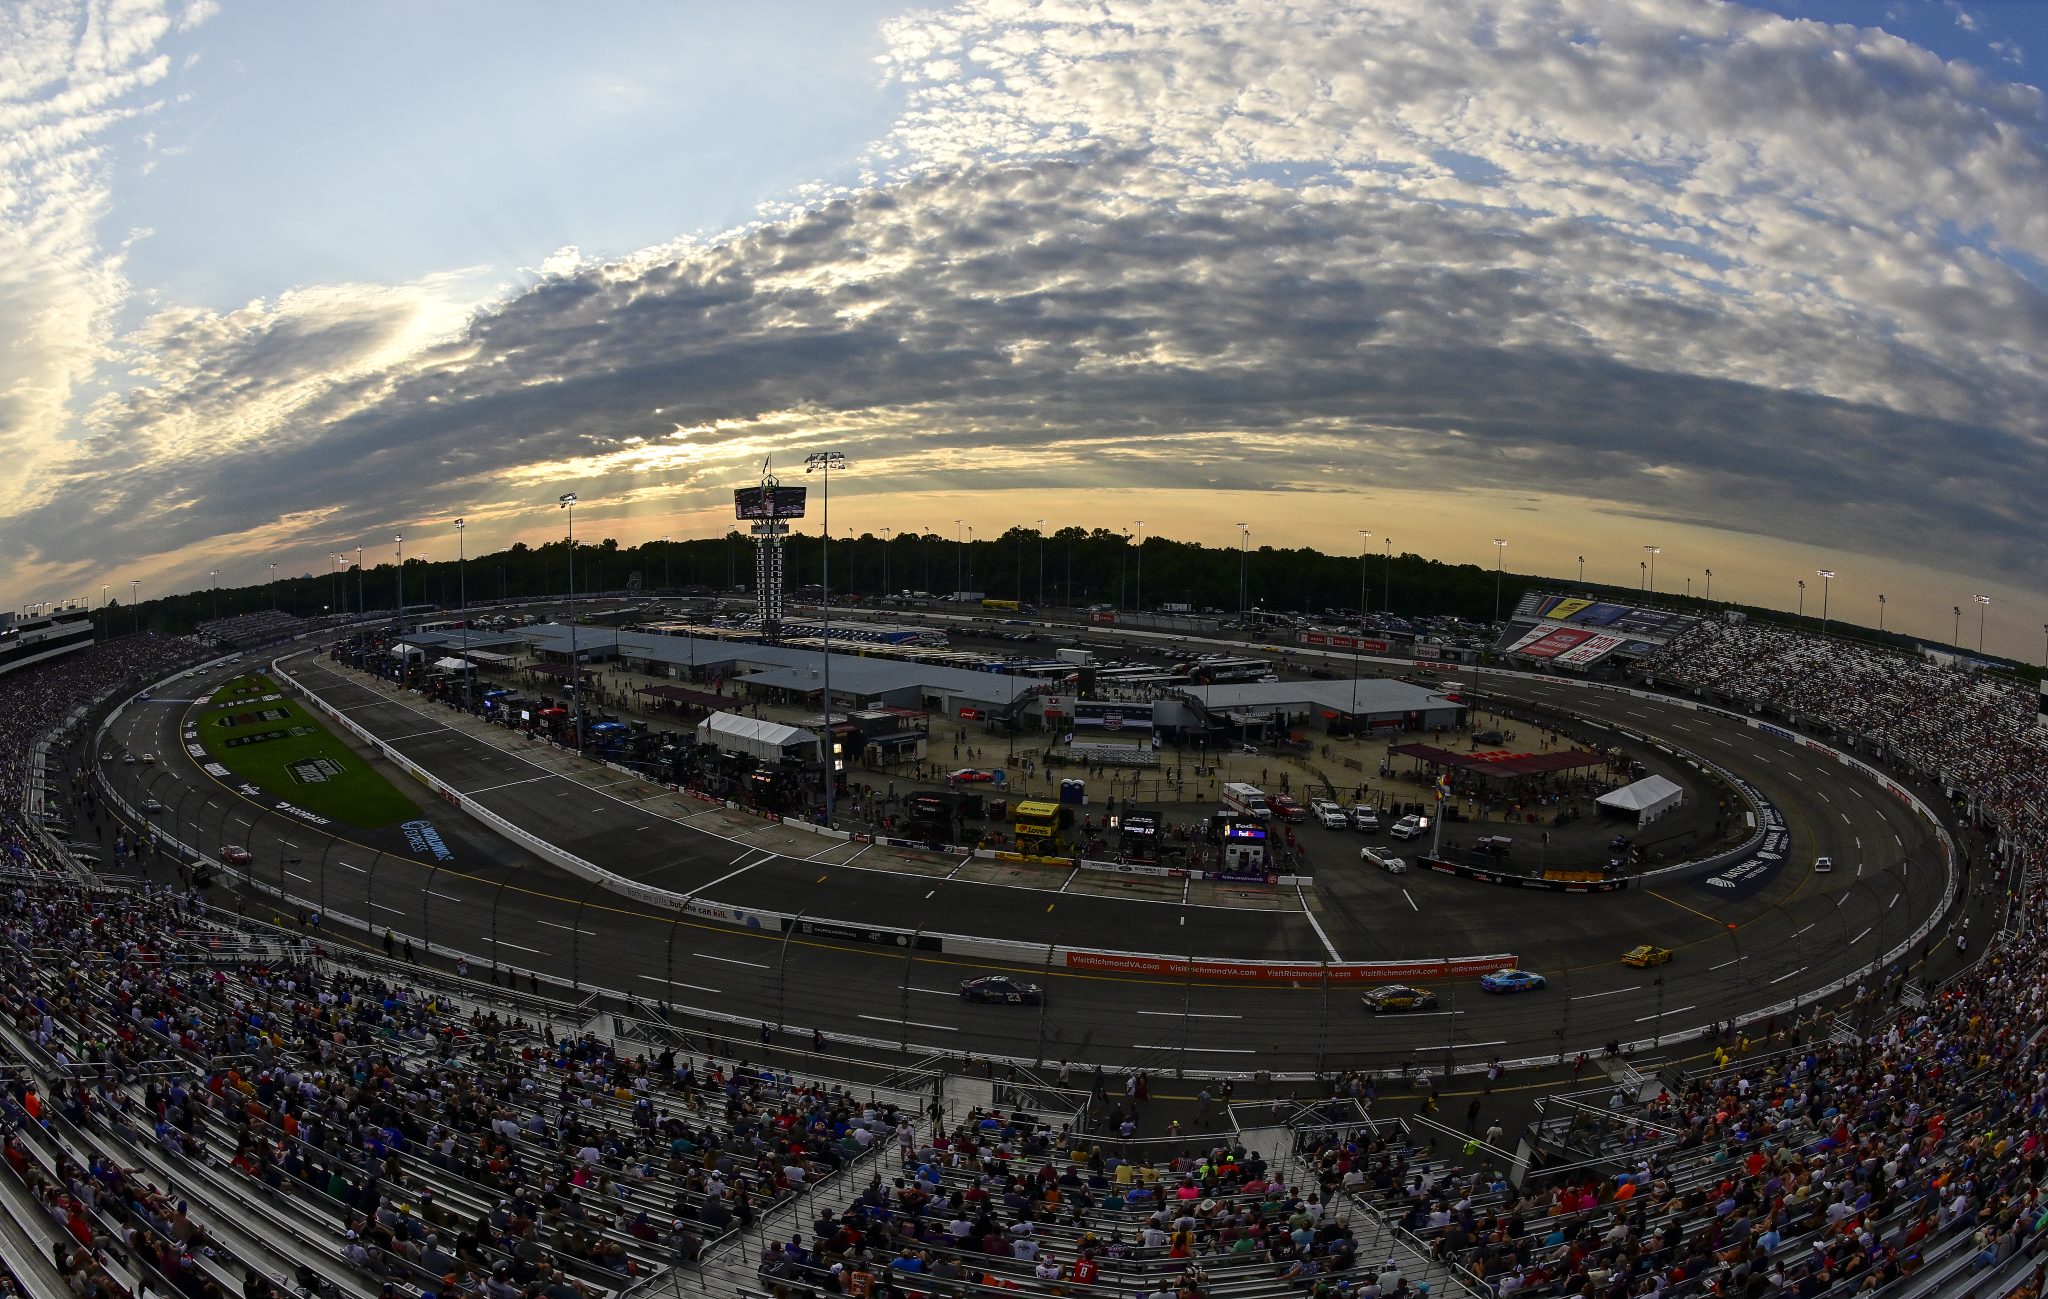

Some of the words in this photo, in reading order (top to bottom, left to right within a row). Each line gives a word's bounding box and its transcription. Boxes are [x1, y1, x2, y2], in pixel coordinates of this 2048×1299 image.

[669, 900, 682, 908] but
[698, 908, 711, 916] can
[1072, 956, 1160, 970] VisitRichmondVA.com
[1360, 968, 1438, 978] VisitRichmondVA.com
[1006, 992, 1022, 1002] 23
[1413, 997, 1424, 1007] 3
[1079, 1266, 1088, 1278] 8
